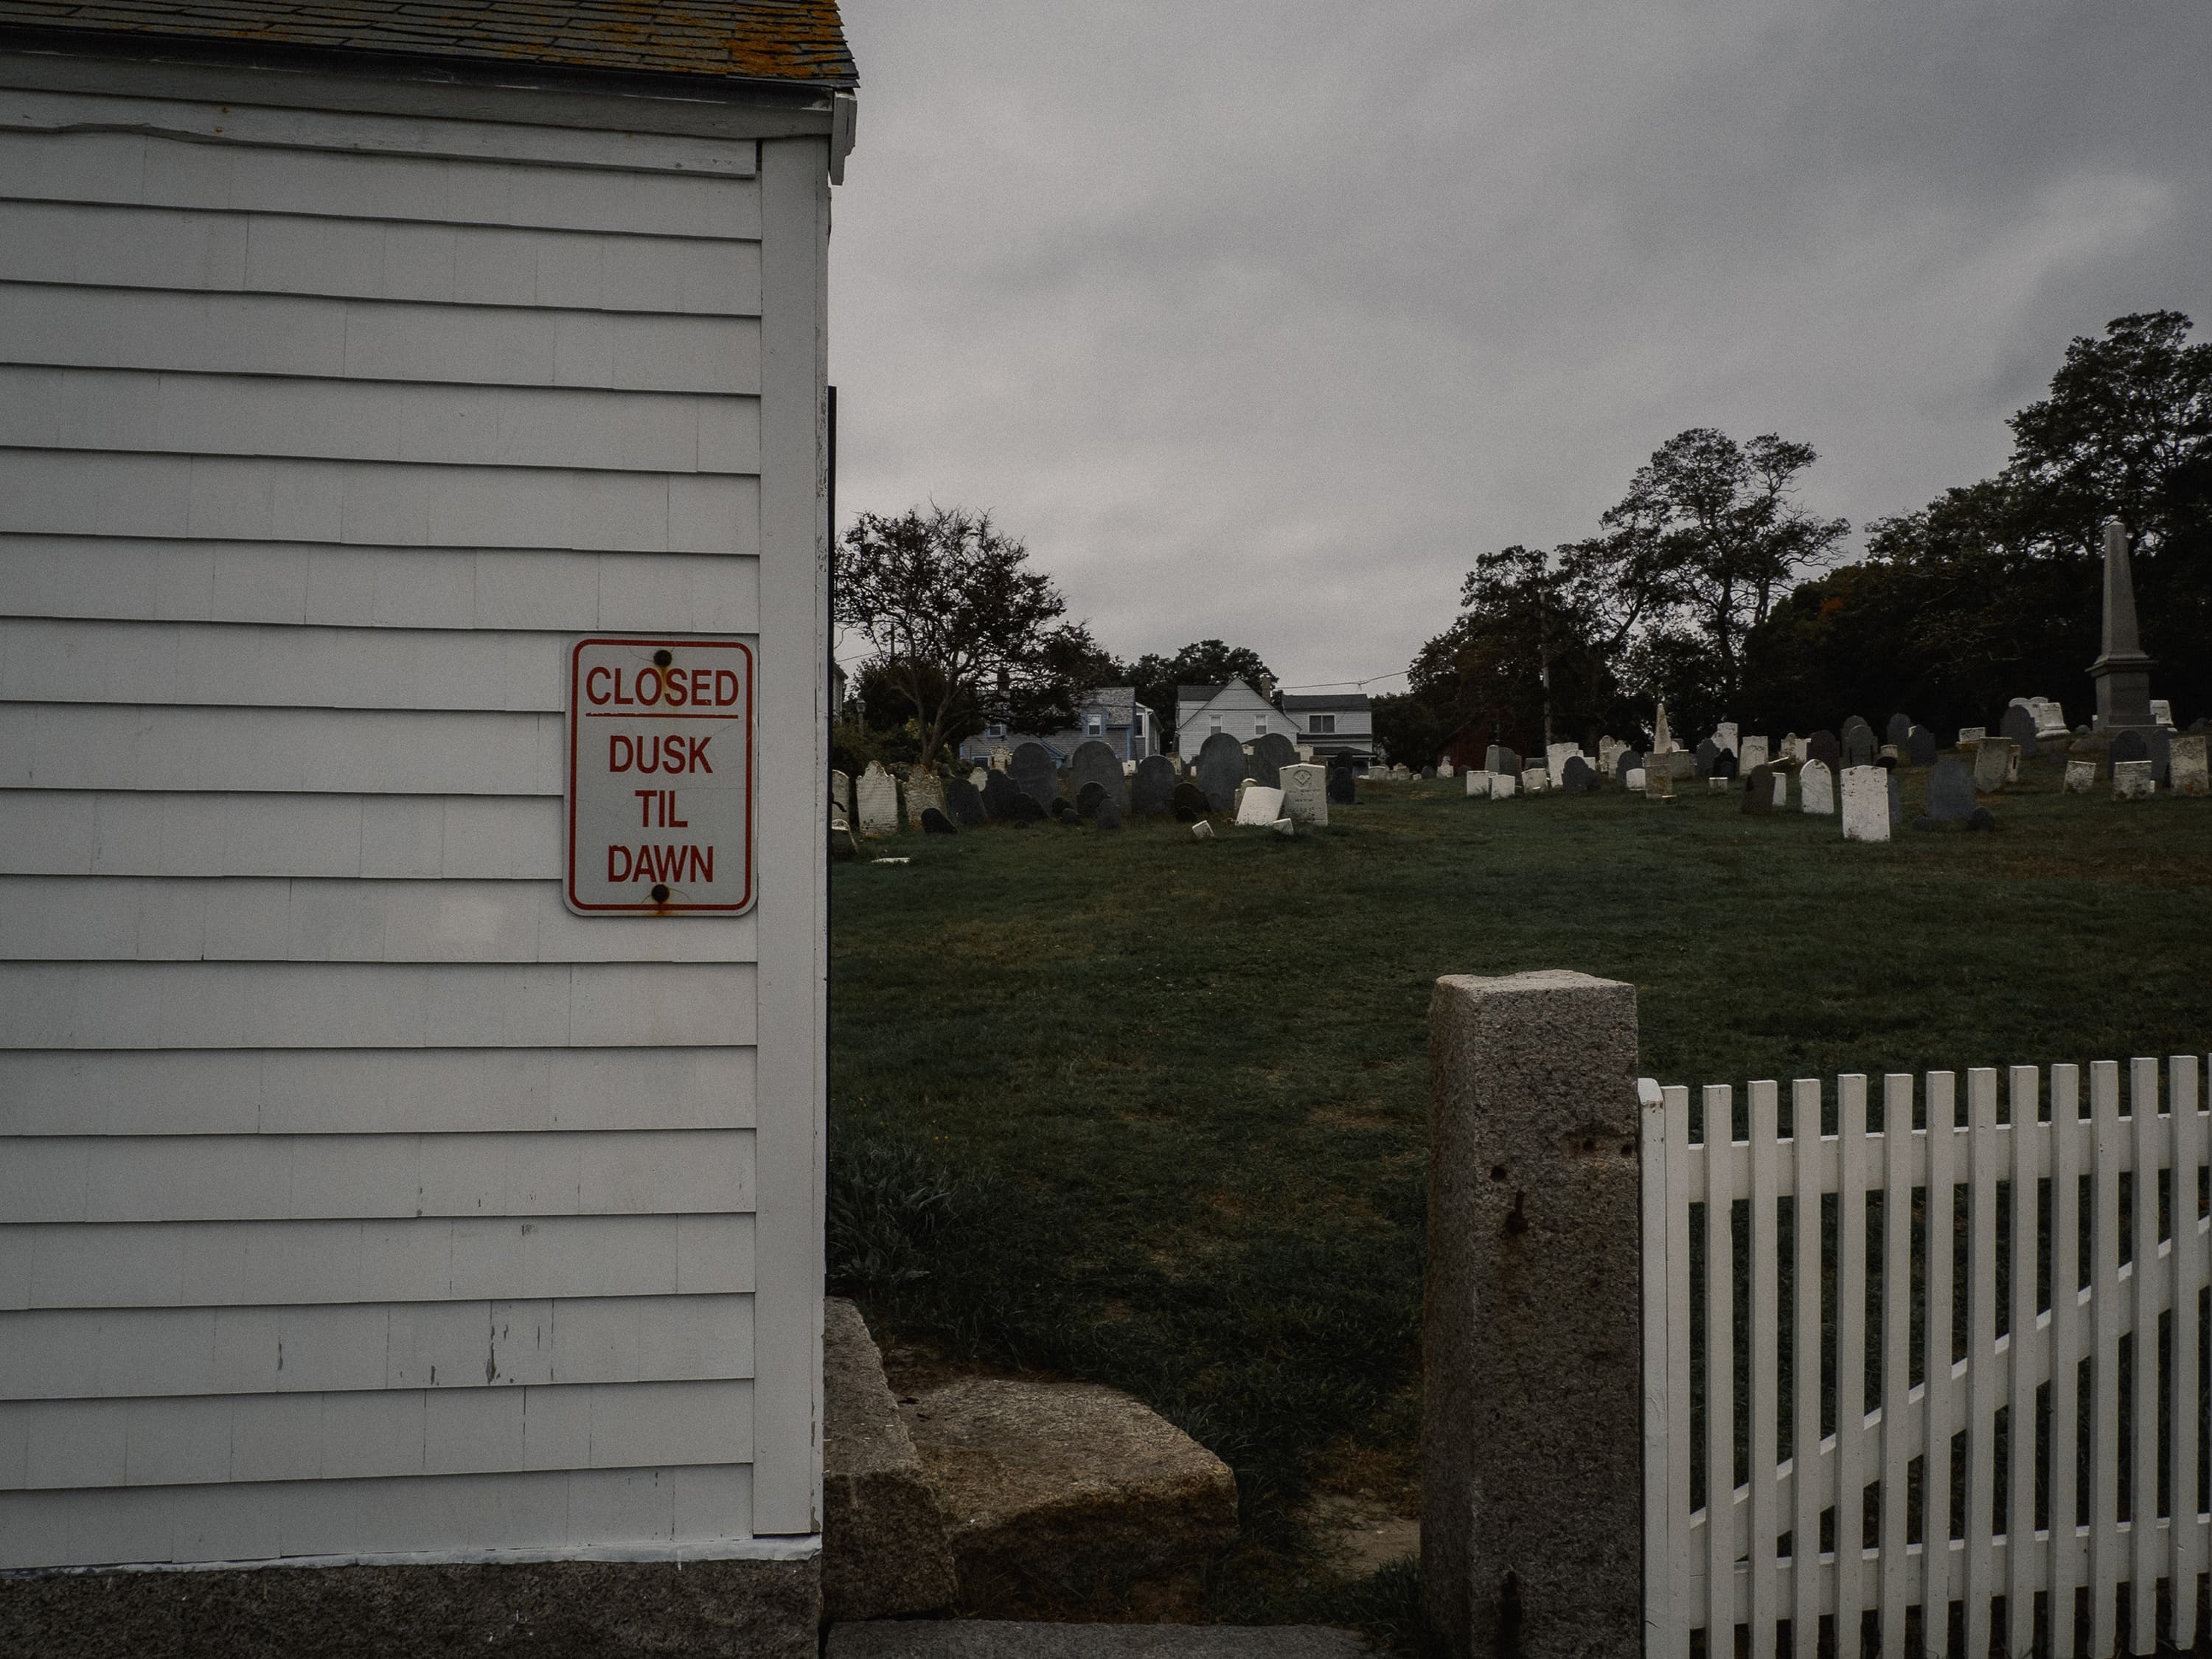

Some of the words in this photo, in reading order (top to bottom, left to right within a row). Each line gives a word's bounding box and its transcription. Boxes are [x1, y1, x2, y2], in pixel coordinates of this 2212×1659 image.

[586, 667, 739, 706] CLOSED
[610, 735, 713, 773] DUSK
[635, 790, 688, 827] TIL
[608, 845, 714, 883] DAWN
